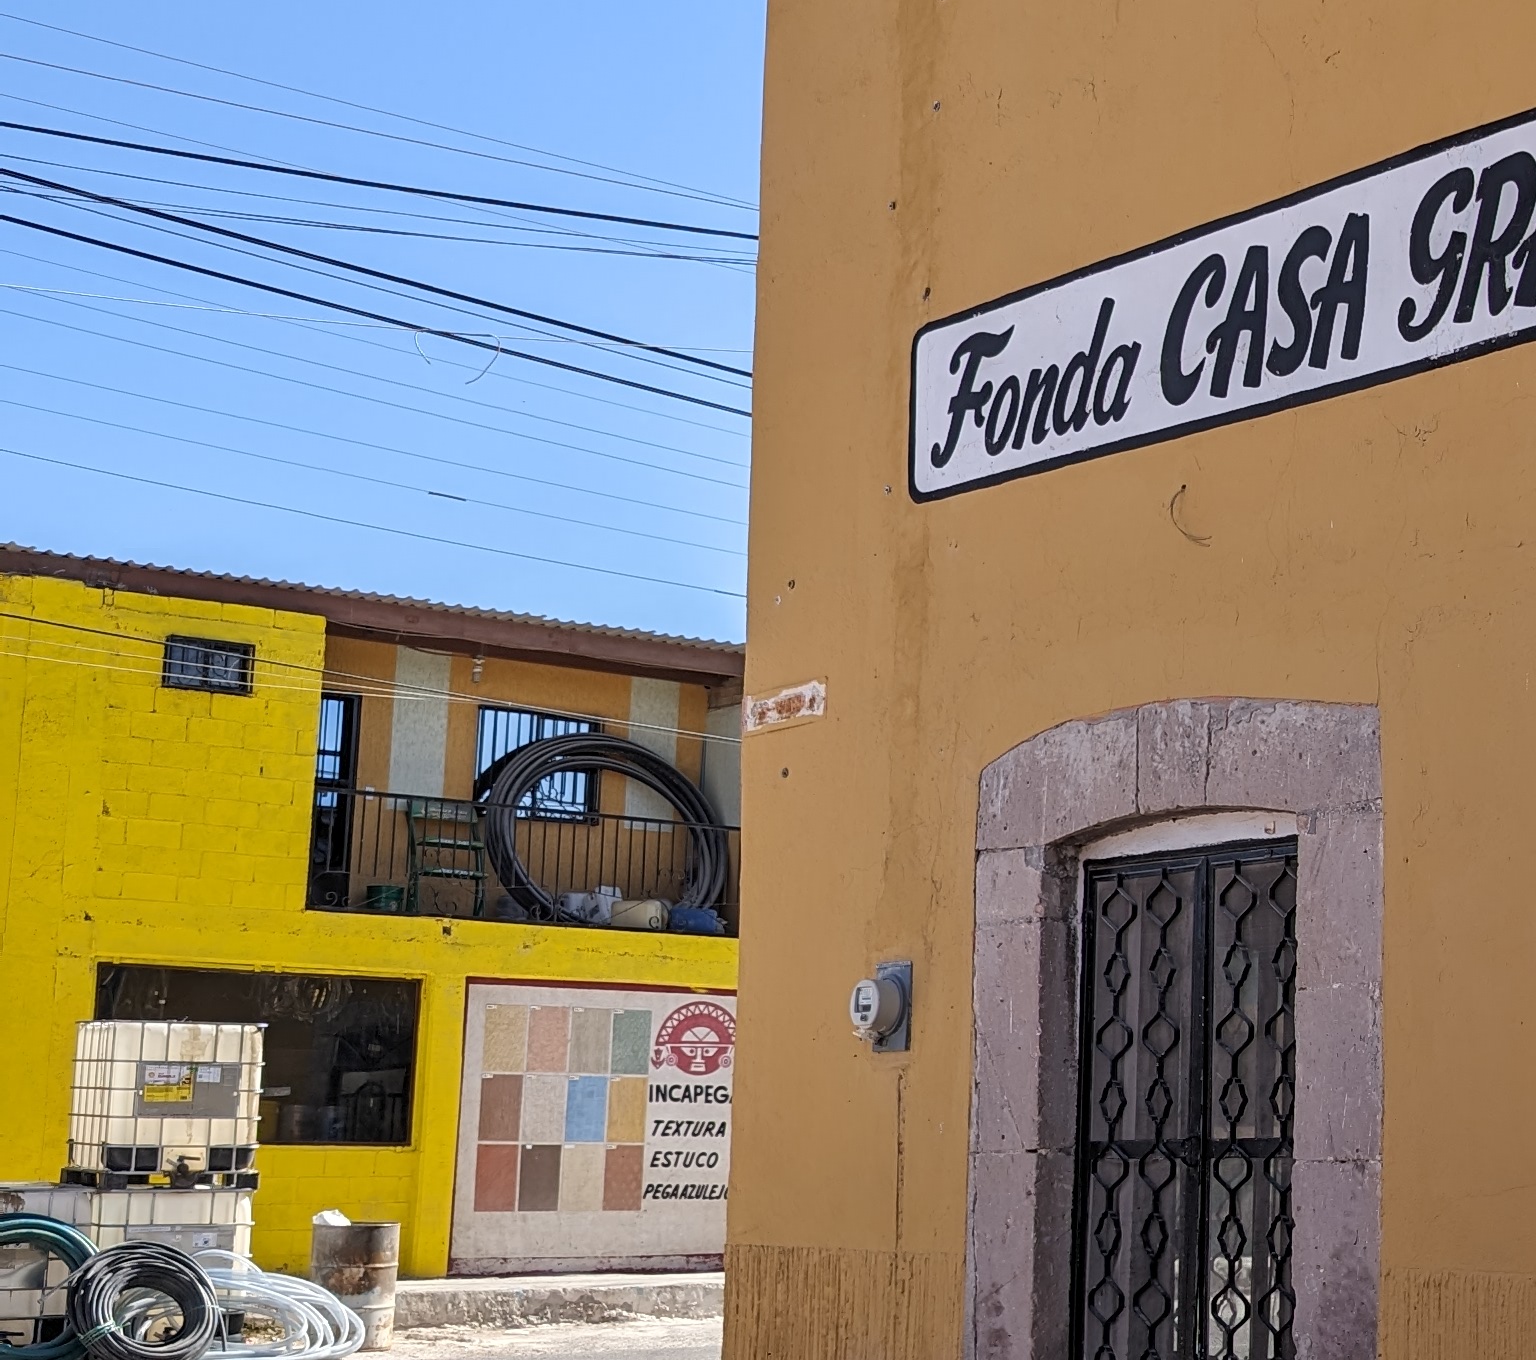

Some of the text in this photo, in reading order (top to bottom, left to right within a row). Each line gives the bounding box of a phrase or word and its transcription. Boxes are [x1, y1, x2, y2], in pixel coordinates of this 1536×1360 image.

[931, 297, 1141, 468] Fonda
[1160, 213, 1369, 406] CASA
[649, 1084, 732, 1104] INCAPEG
[651, 1120, 727, 1137] TEXTURA
[650, 1151, 719, 1169] ESTUCO
